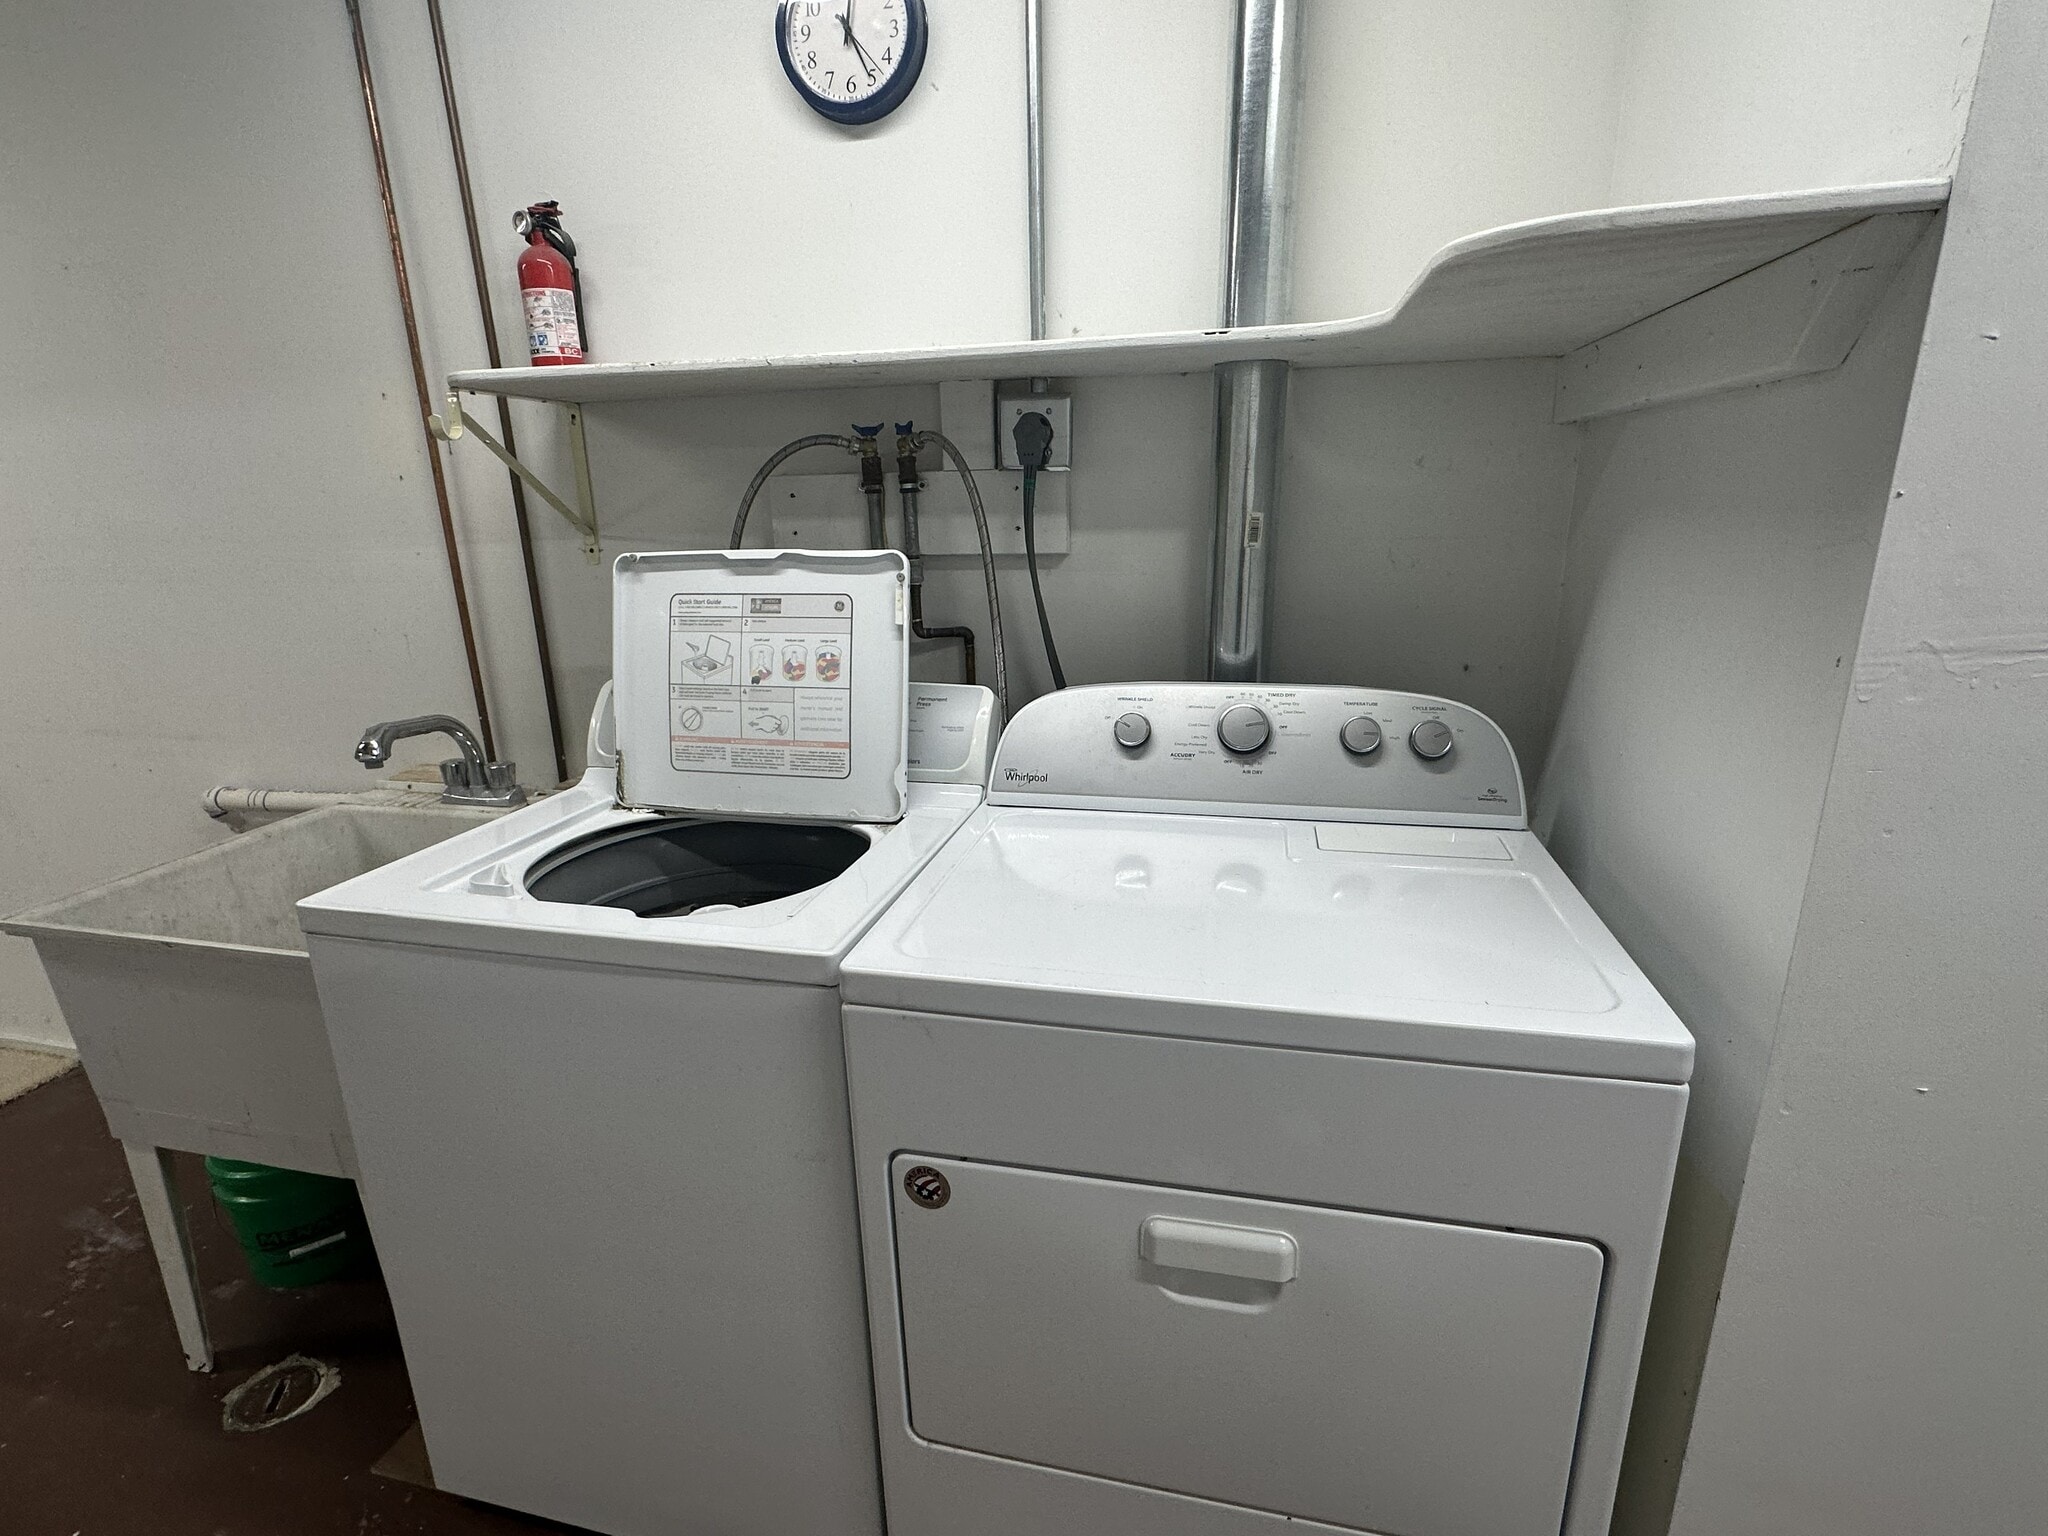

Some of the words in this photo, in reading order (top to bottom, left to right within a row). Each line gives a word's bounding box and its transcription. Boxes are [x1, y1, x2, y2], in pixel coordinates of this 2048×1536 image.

[806, 2, 820, 16] 10
[801, 24, 811, 43] 9
[889, 19, 899, 38] 3
[807, 51, 817, 69] 8
[881, 47, 892, 64] 4
[825, 71, 834, 89] 7
[846, 75, 856, 93] 6
[867, 69, 876, 87] 5
[564, 347, 580, 356] BC
[1004, 771, 1048, 784] Whirlpool
[906, 1168, 940, 1188] AMERICA
